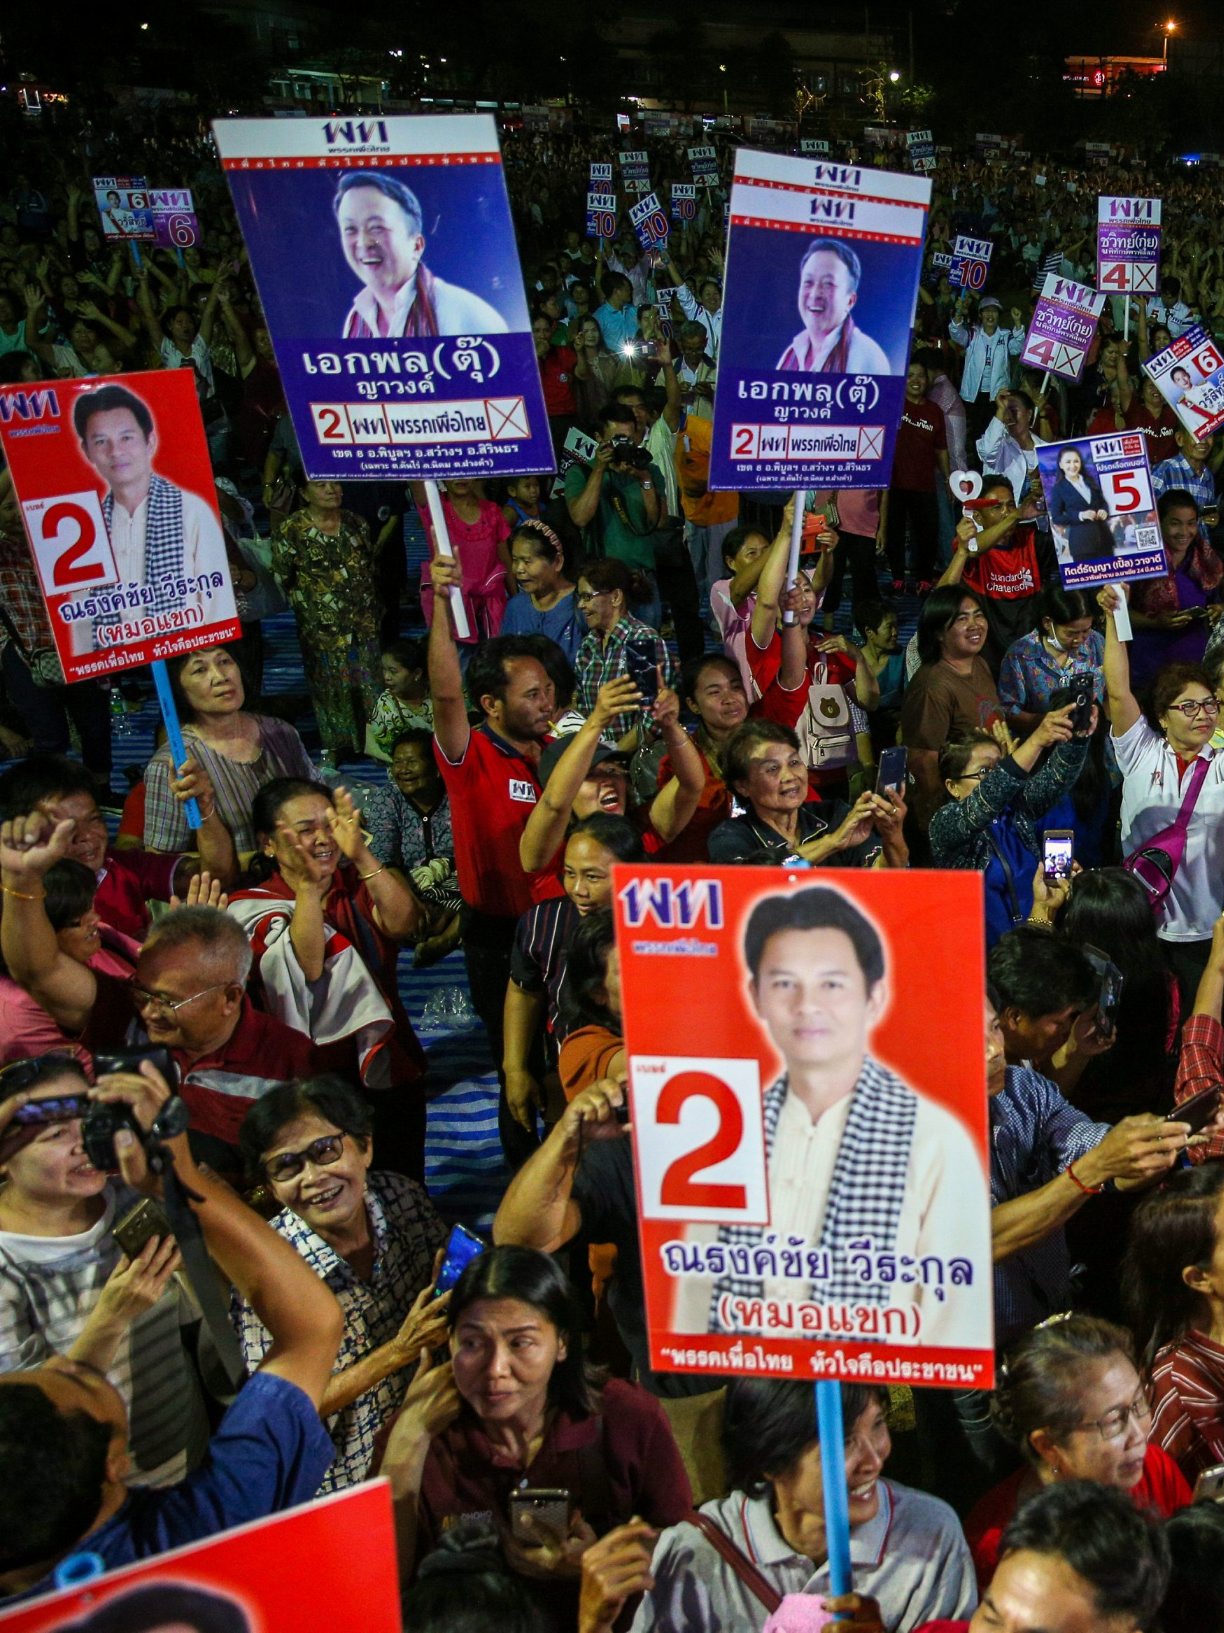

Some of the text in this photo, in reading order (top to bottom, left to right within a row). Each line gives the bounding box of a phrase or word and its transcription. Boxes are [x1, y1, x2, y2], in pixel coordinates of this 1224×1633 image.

[322, 120, 388, 144] พท
[814, 164, 861, 186] พท
[914, 159, 926, 170] 4
[626, 180, 638, 191] 4
[132, 194, 144, 208] 6
[676, 198, 696, 220] 10
[810, 198, 855, 220] พท
[1109, 199, 1152, 218] พท
[168, 214, 195, 248] 6
[592, 212, 616, 238] 10
[642, 212, 668, 243] 10
[958, 258, 987, 290] 10
[1102, 264, 1130, 290] 4
[1028, 339, 1055, 366] 4
[1198, 351, 1218, 374] 6
[357, 371, 435, 399] ญาวงค์
[318, 408, 345, 438] 2
[391, 411, 486, 434] พรรคเพื่อไทย
[774, 400, 832, 422] ญาวงค์
[332, 449, 352, 458] เขต
[735, 428, 754, 455] 2
[791, 434, 857, 452] พรรคเพื่อไทย
[1112, 472, 1142, 512] 5
[41, 502, 106, 588] 2
[60, 569, 224, 622] ณรงค์ชัย วีระกุล
[96, 605, 205, 648] (หมอแขก)
[618, 877, 723, 930] พท
[655, 1071, 747, 1209] 2
[662, 1235, 975, 1303] ณรงค์ชัย วีระกุล
[720, 1299, 921, 1338] (หมอแขก)
